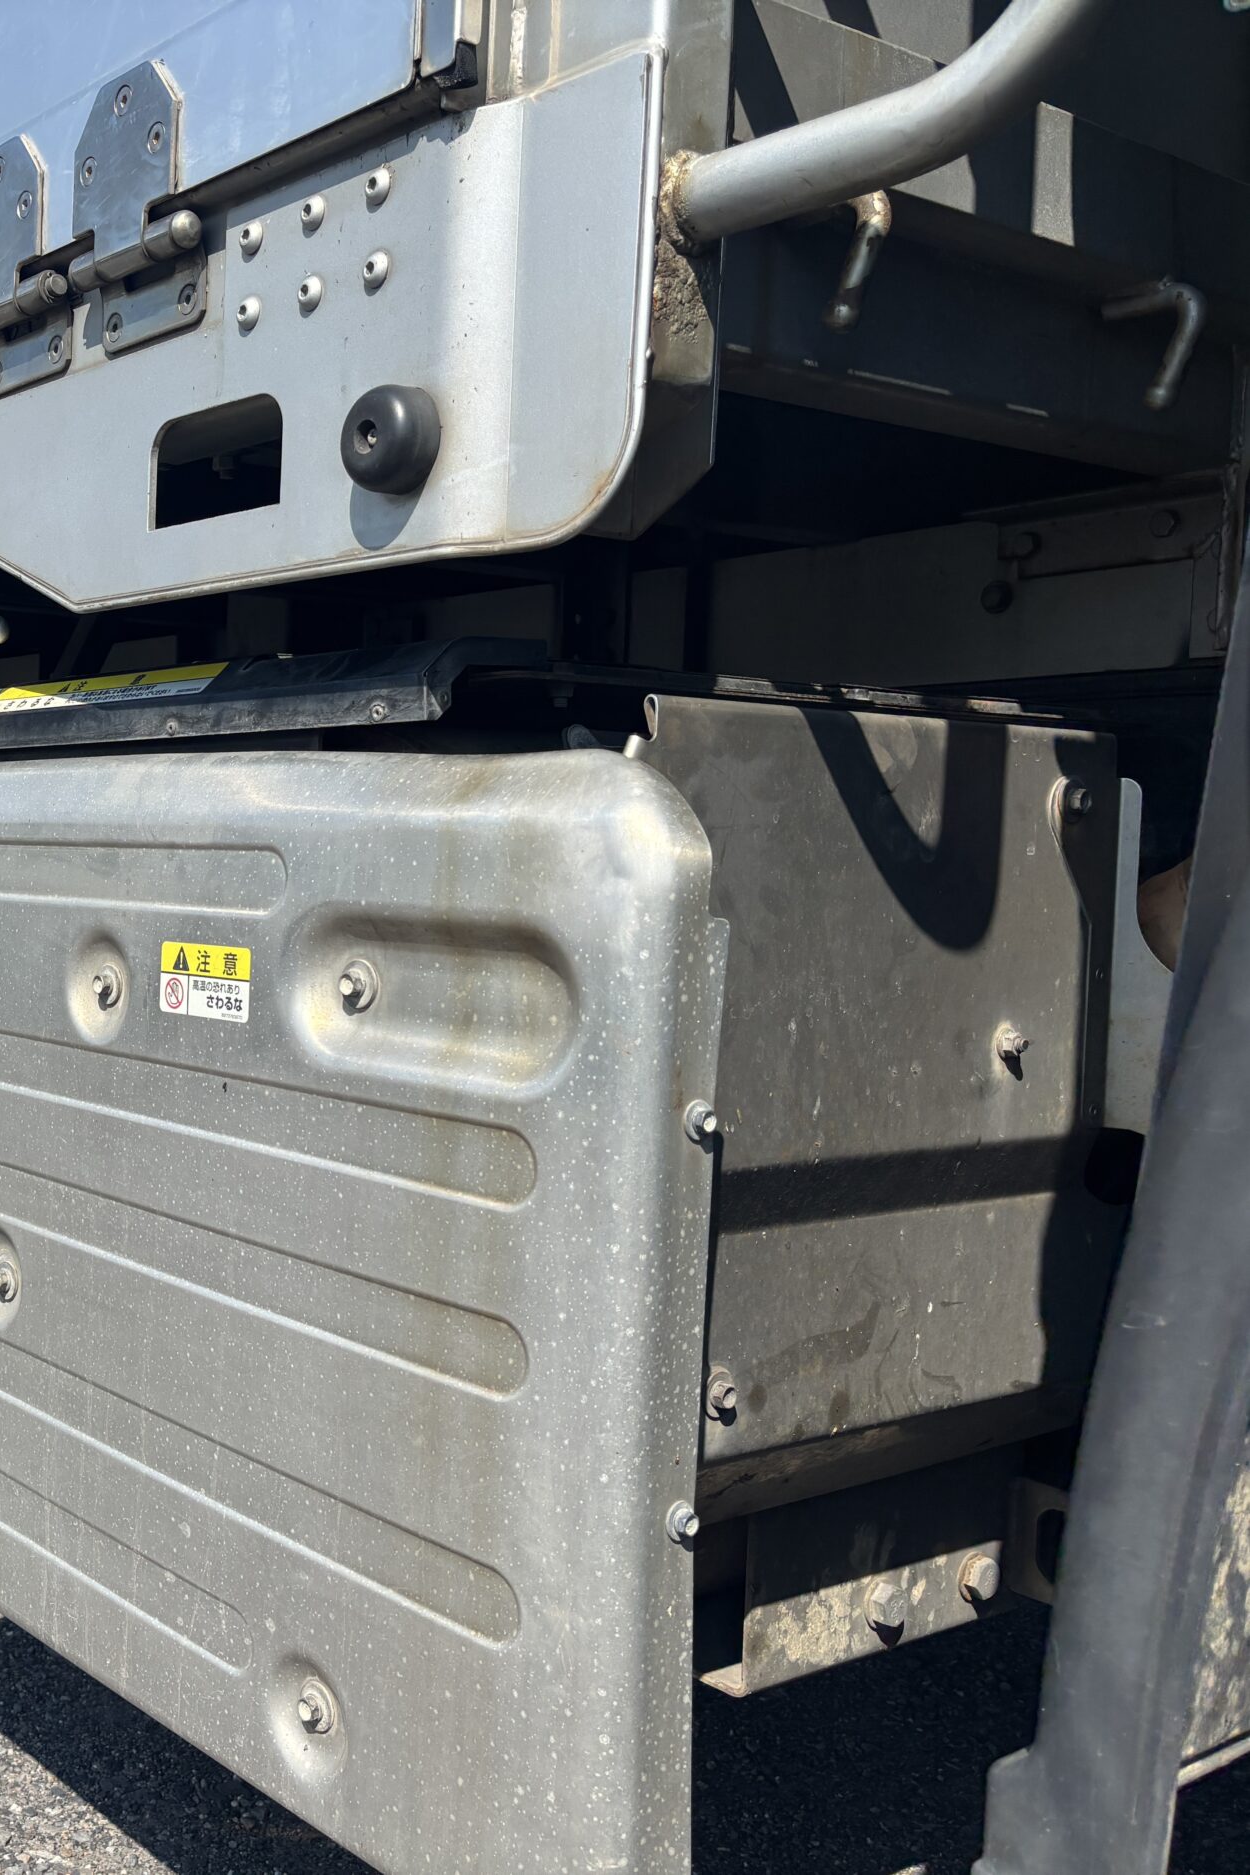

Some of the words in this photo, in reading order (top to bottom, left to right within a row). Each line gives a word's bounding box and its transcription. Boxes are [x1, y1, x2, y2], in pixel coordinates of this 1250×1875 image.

[196, 950, 238, 976] 注意
[192, 980, 240, 995] 高温の恐れあり
[206, 995, 243, 1012] さわるな
